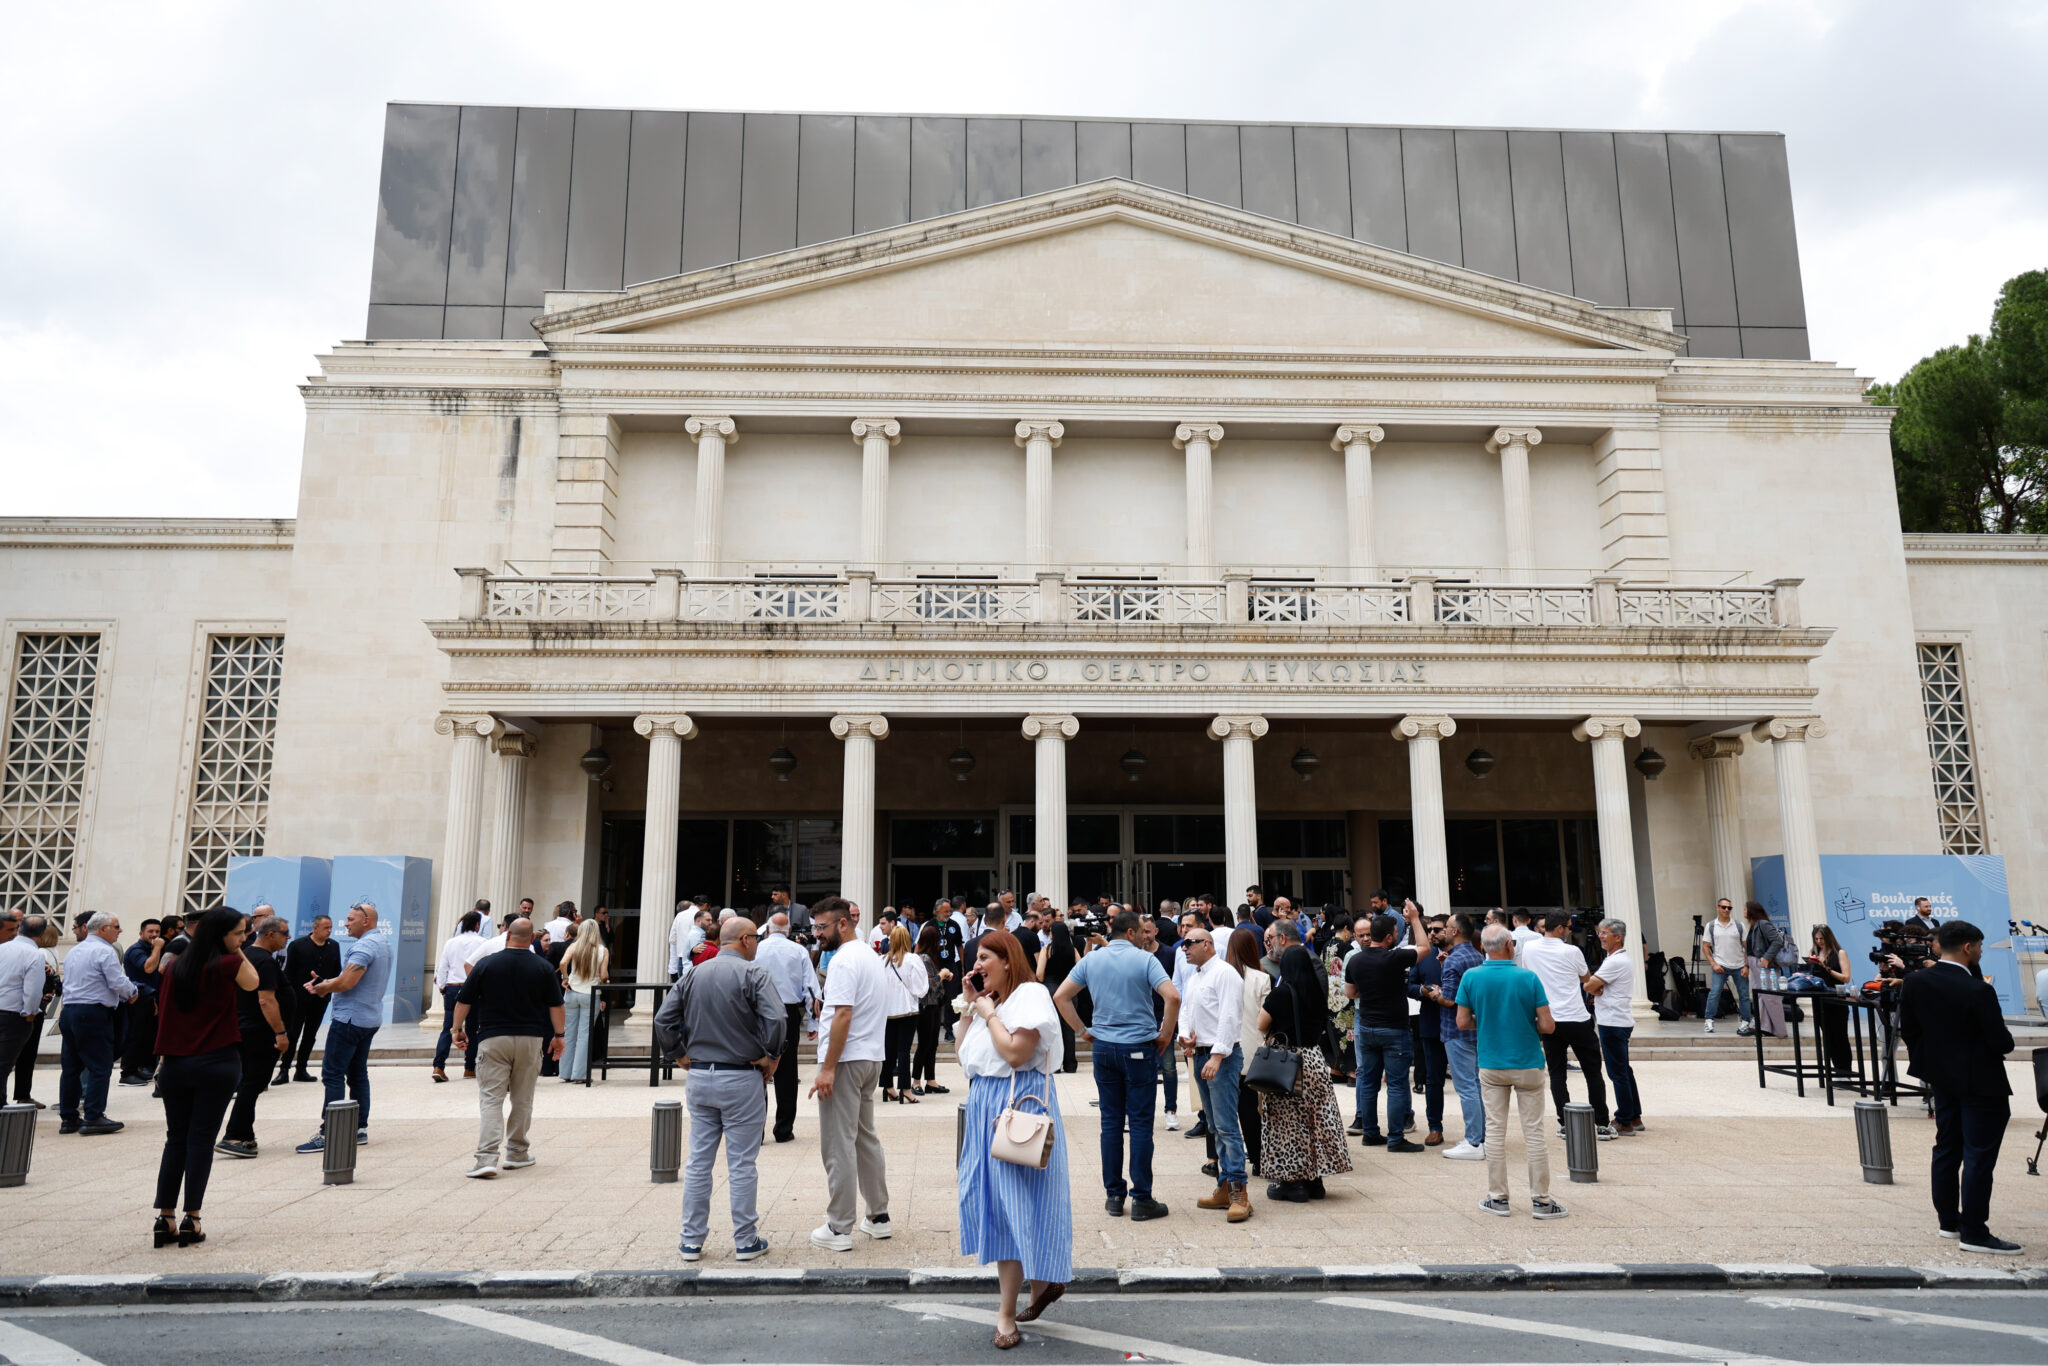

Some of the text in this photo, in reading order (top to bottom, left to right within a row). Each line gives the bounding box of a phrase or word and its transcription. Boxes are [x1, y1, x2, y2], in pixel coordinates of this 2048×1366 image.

[859, 661, 1426, 683] ΔΗΜΟΤΙΚΟ ΘΕΑΤΡΟ ΛΕΥΚΩΣΙΑΣ
[1871, 891, 1953, 906] Βουλεικές
[1868, 905, 1917, 921] εκλογέ
